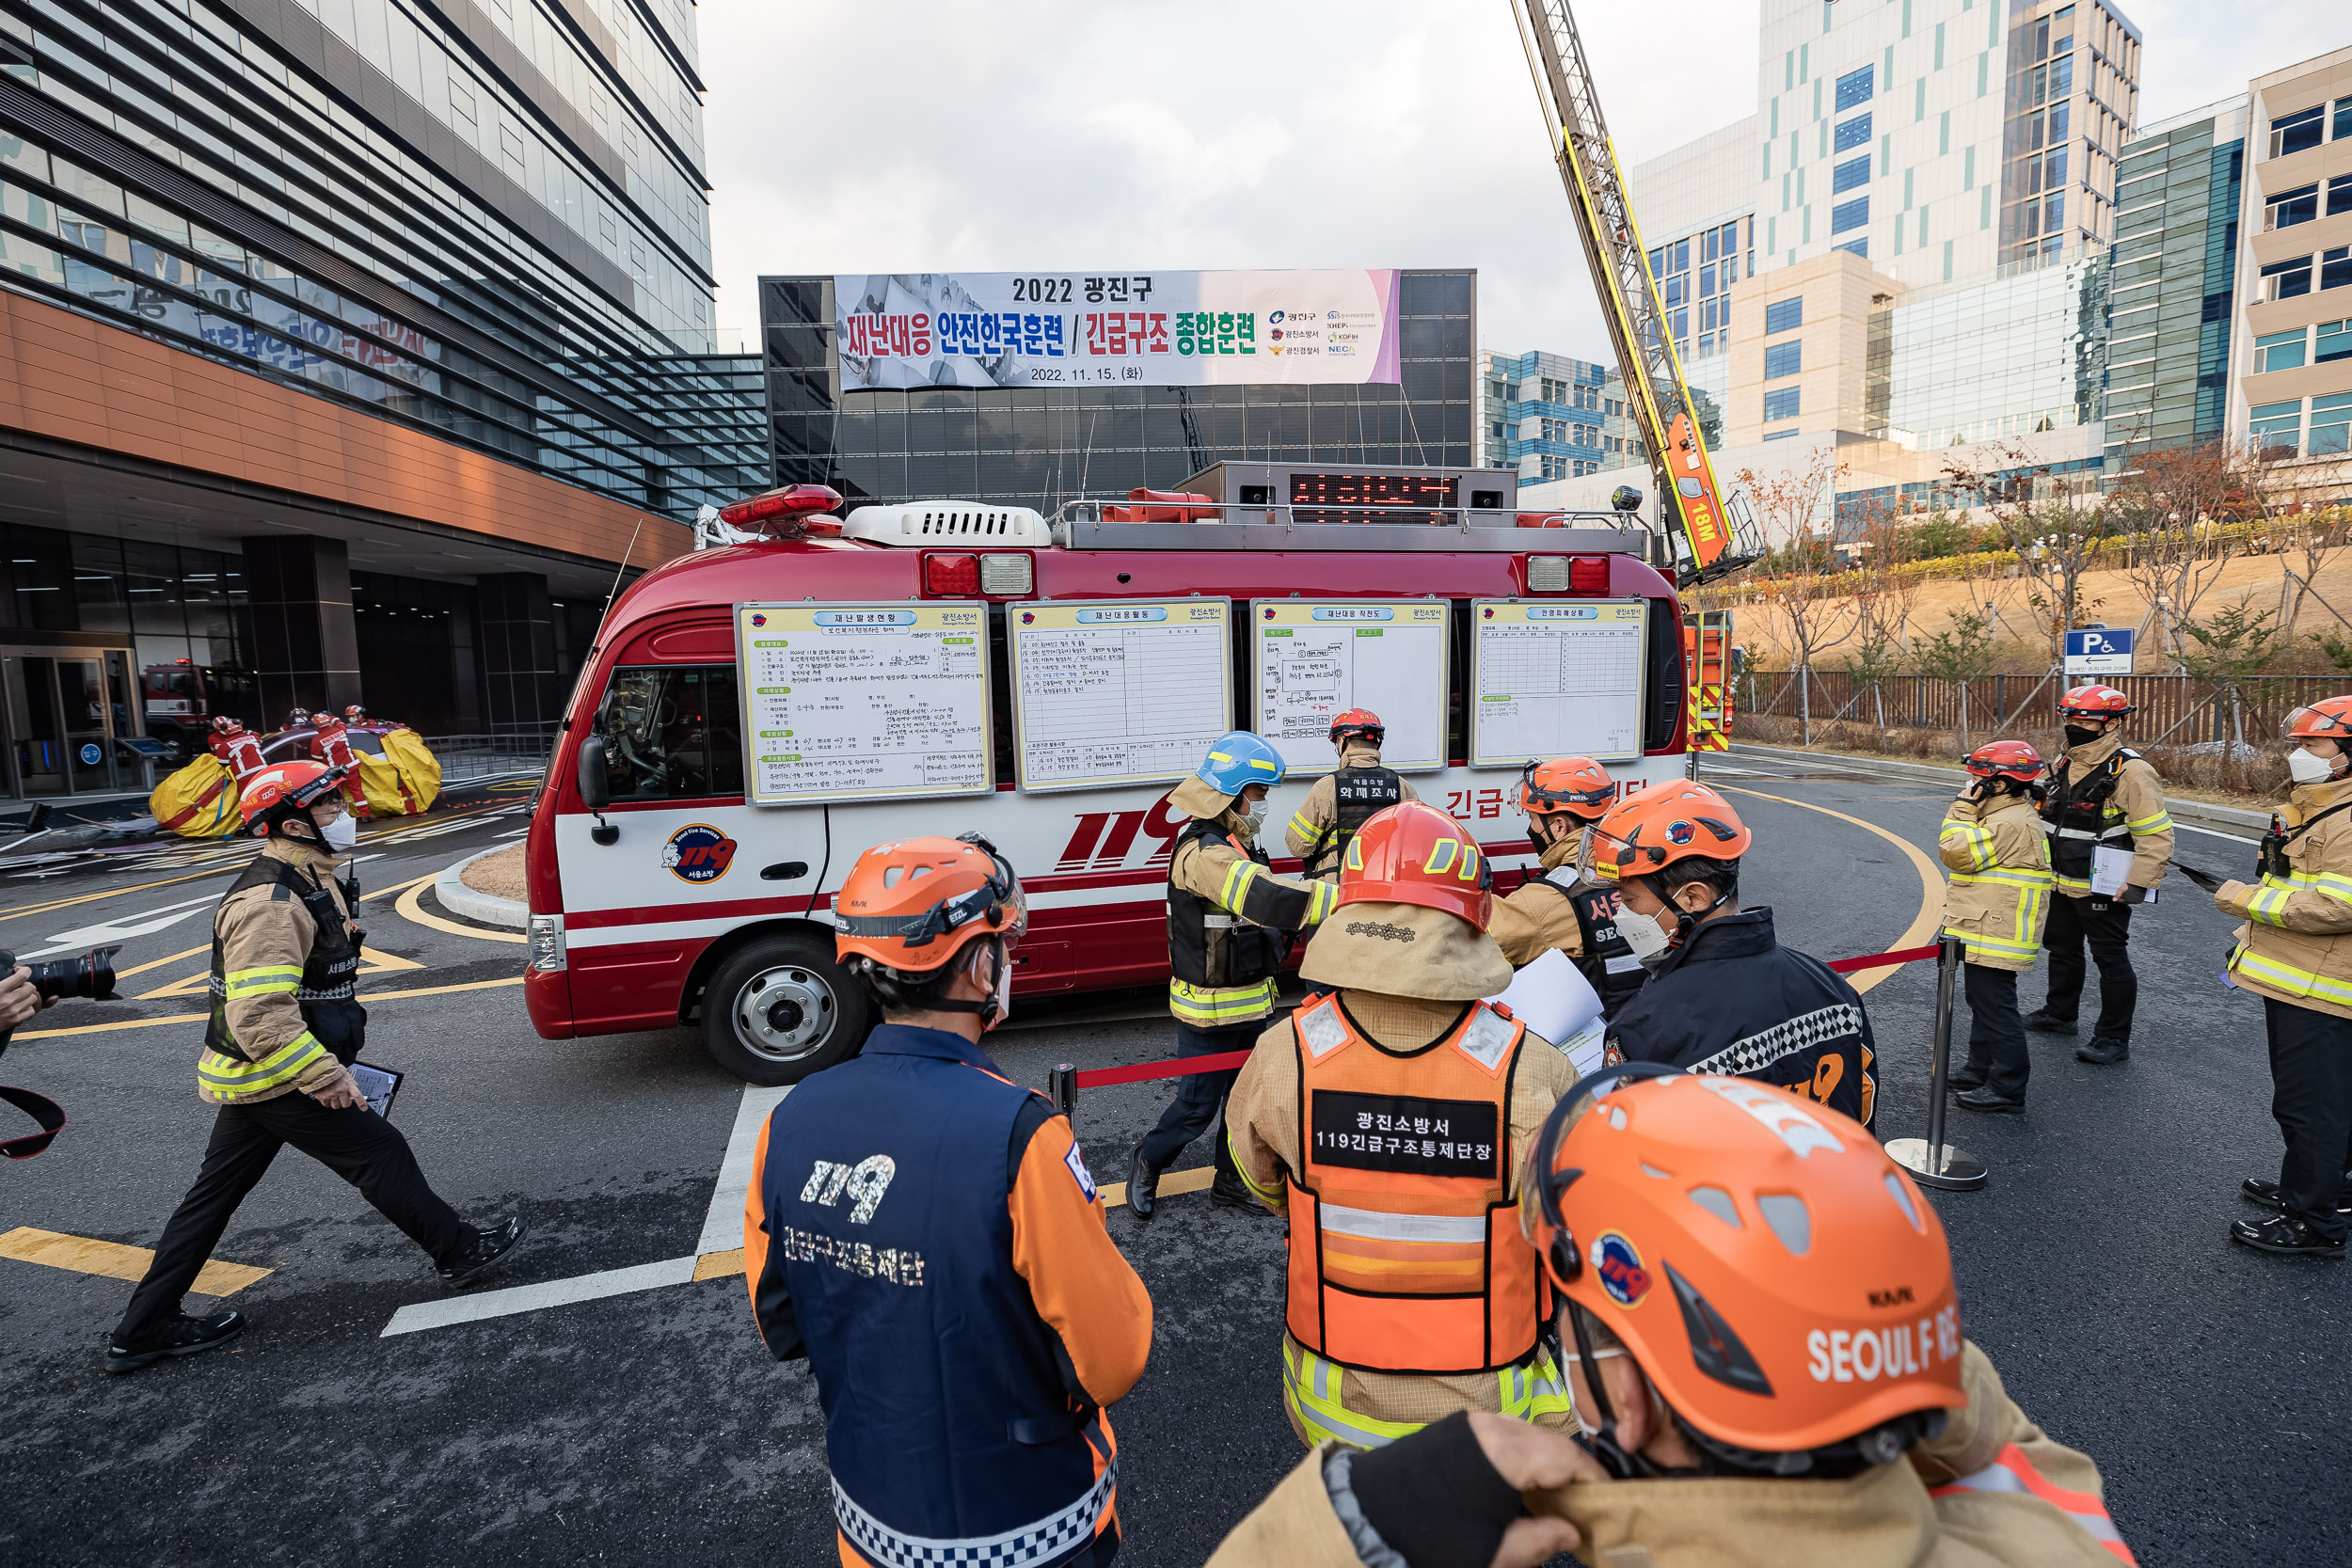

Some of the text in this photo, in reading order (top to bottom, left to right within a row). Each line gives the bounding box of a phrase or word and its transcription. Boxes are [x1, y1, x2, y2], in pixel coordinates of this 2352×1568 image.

[1013, 277, 1152, 303] 2022 광진구
[1288, 312, 1316, 321] 광진구
[847, 313, 930, 356] 재난대응
[938, 312, 1064, 356] 안전한국훈련
[1086, 312, 1169, 356] 긴급구조
[1176, 311, 1256, 356] 종합훈련
[1285, 329, 1319, 339] 광진소방서
[1286, 346, 1320, 356] 광진경찰서
[1031, 366, 1143, 381] 2022. 11. 15. (화)
[1692, 502, 1716, 542] 18M
[834, 614, 896, 623] 재난발생현황
[1095, 610, 1149, 620] 재난대응활동
[1190, 608, 1220, 616] 광진소방서
[1327, 610, 1356, 618] 재난대응
[2083, 633, 2103, 654] P
[246, 780, 293, 806] 서울 119 소방
[1340, 786, 1398, 799] 화재조사
[675, 831, 689, 842] Seoul
[699, 828, 719, 840] Services
[677, 839, 738, 869] 119
[688, 870, 714, 879] 서울소방
[327, 956, 357, 974] 서울소방
[1356, 1111, 1450, 1136] 광진소방서
[1316, 1131, 1492, 1161] 119긴급구조통제단장
[800, 1153, 896, 1225] 119
[1806, 1325, 1919, 1383] SEOUL
